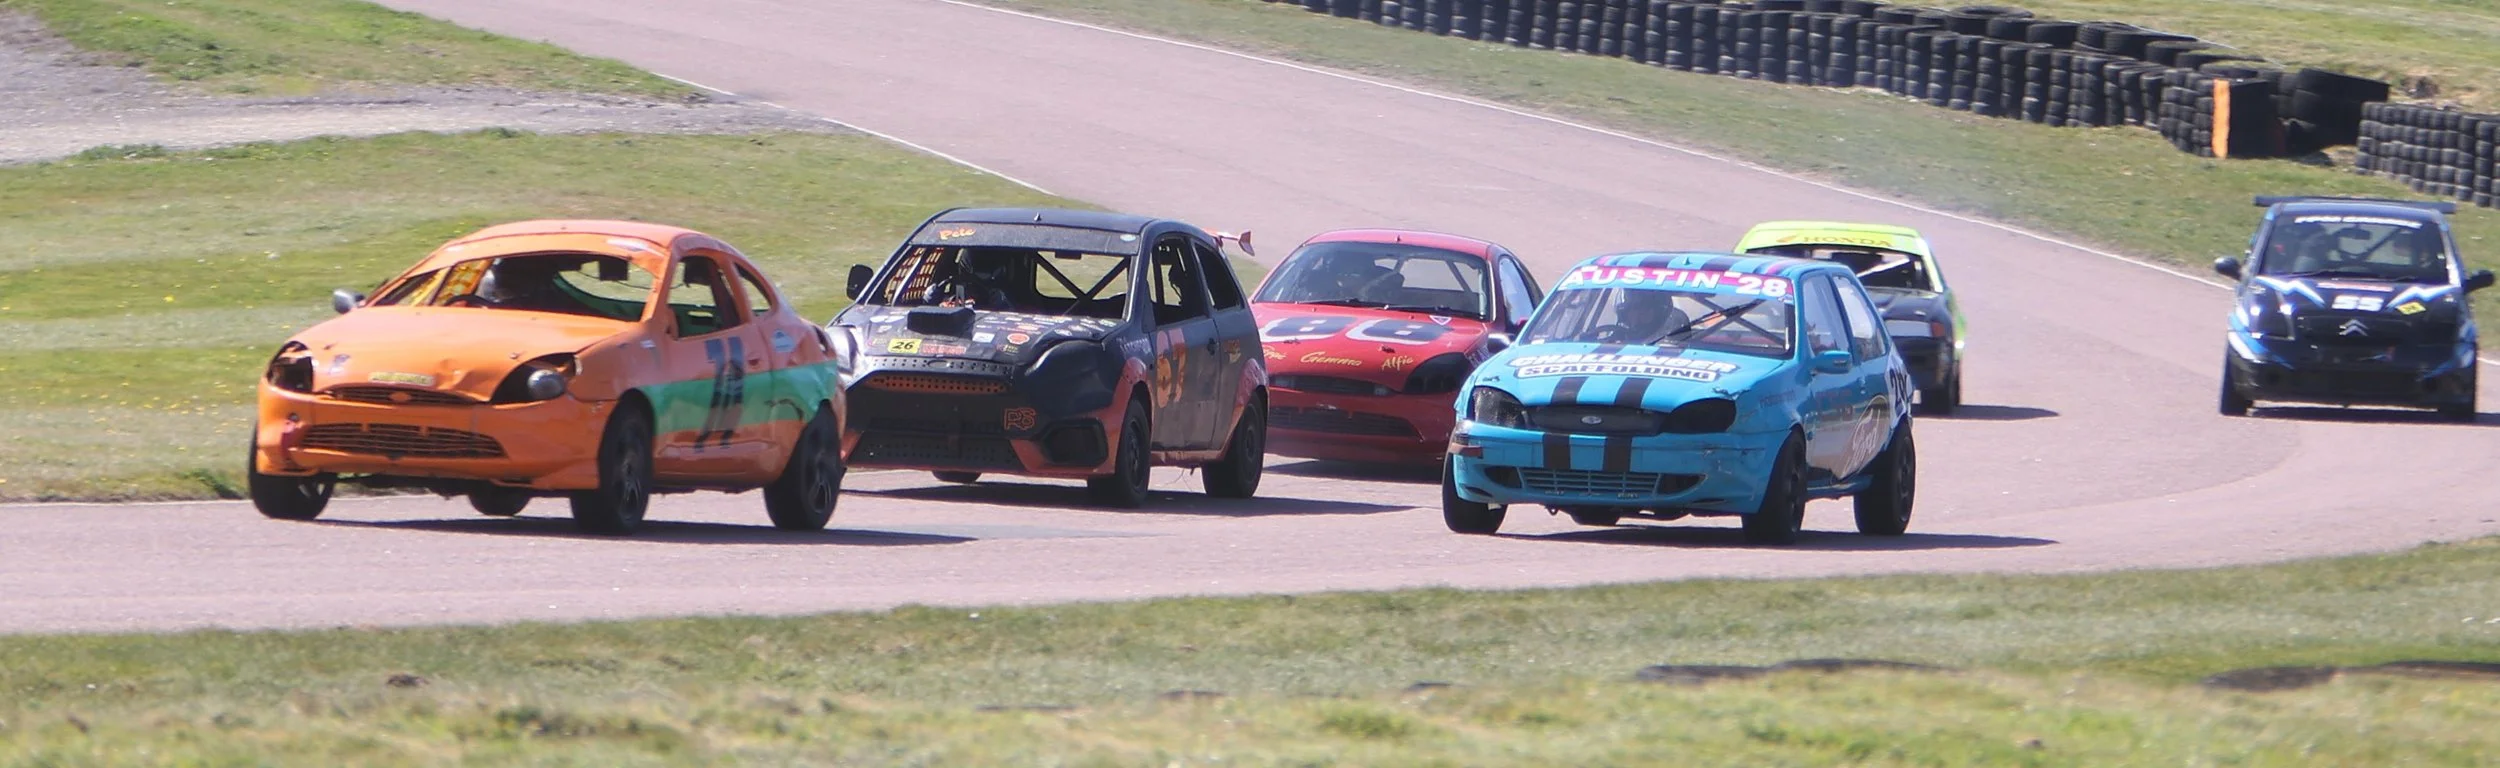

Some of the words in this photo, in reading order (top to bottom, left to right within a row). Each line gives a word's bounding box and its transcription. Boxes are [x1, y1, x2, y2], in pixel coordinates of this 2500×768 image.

[1803, 236, 1893, 247] HONDA
[1562, 267, 1721, 289] AUSTIN
[1735, 276, 1788, 297] 28
[1261, 316, 1452, 345] 88
[891, 340, 915, 350] 26
[1381, 355, 1414, 371] Alfie
[1510, 353, 1738, 373] CHALLENGER
[1523, 363, 1711, 380] SCAFFOLDING
